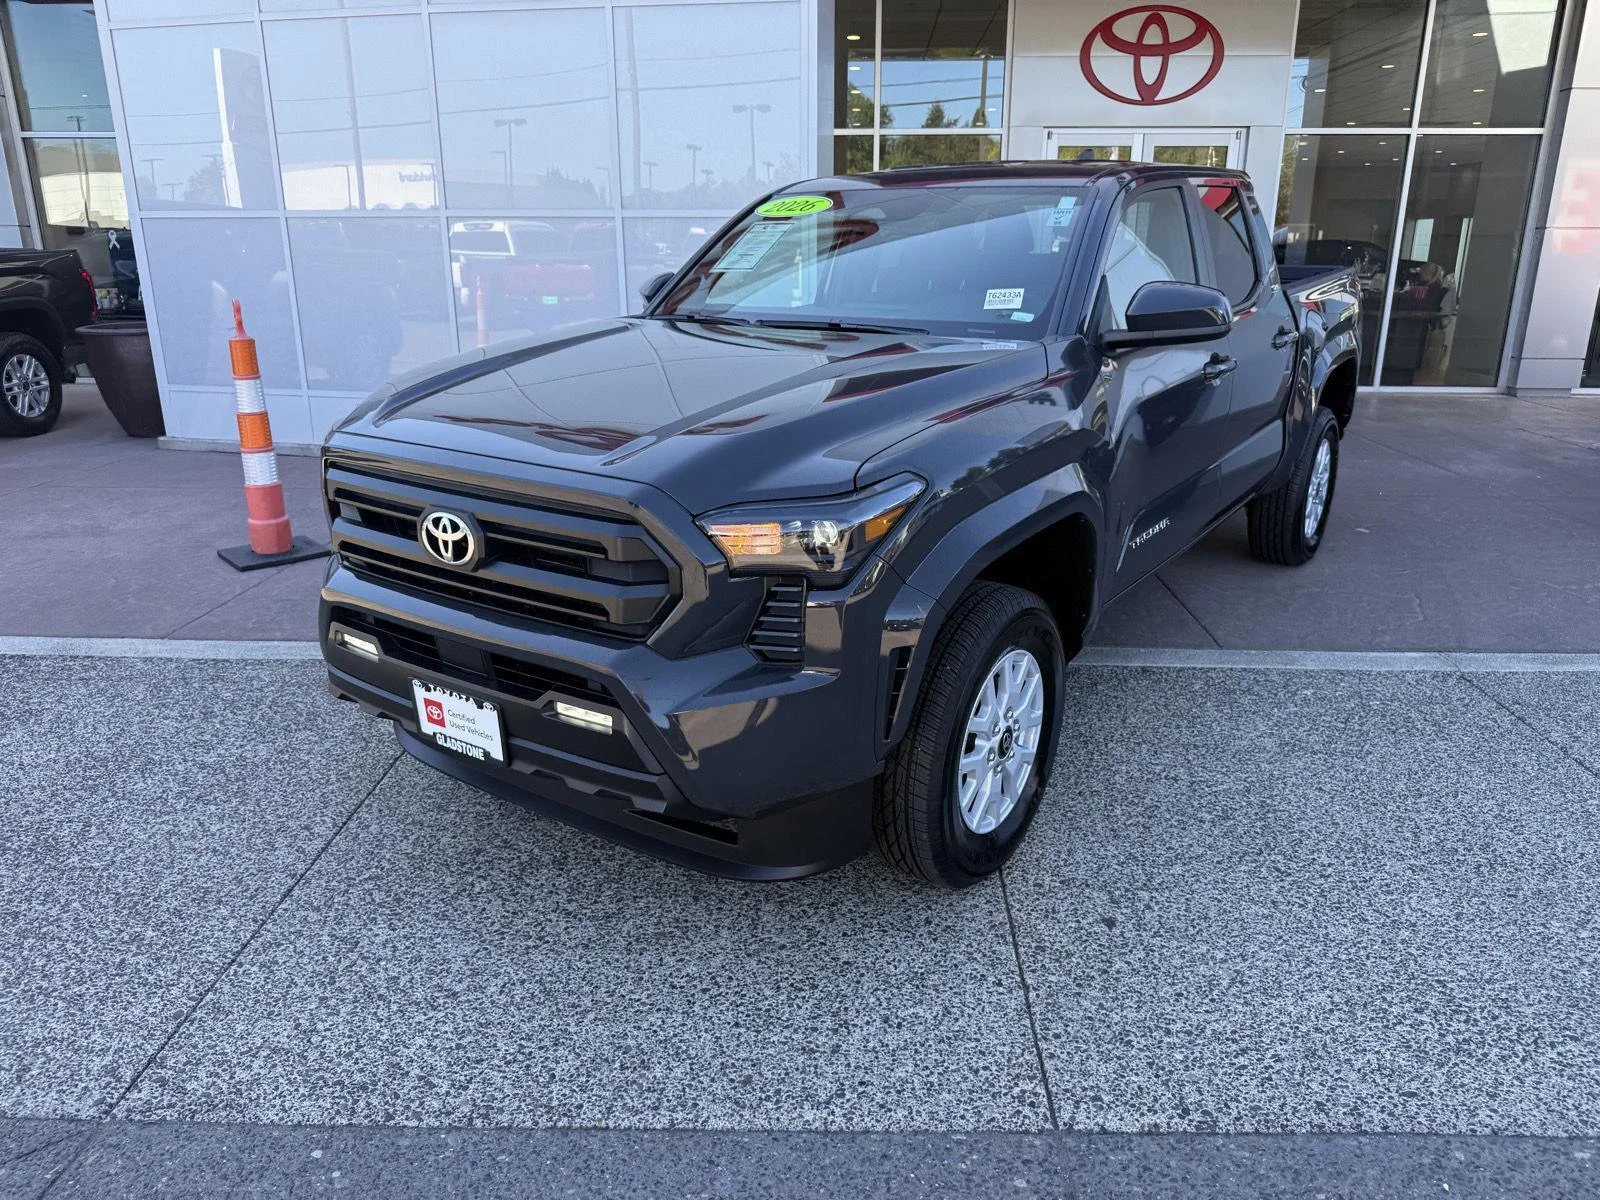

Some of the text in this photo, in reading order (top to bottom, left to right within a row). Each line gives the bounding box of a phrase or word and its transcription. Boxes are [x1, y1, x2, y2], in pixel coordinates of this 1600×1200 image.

[763, 200, 824, 213] 2026
[428, 683, 477, 705] TOYOTA
[447, 709, 476, 725] Certified
[449, 720, 494, 741] Used Vehicles
[436, 733, 485, 760] GLADSTONE
